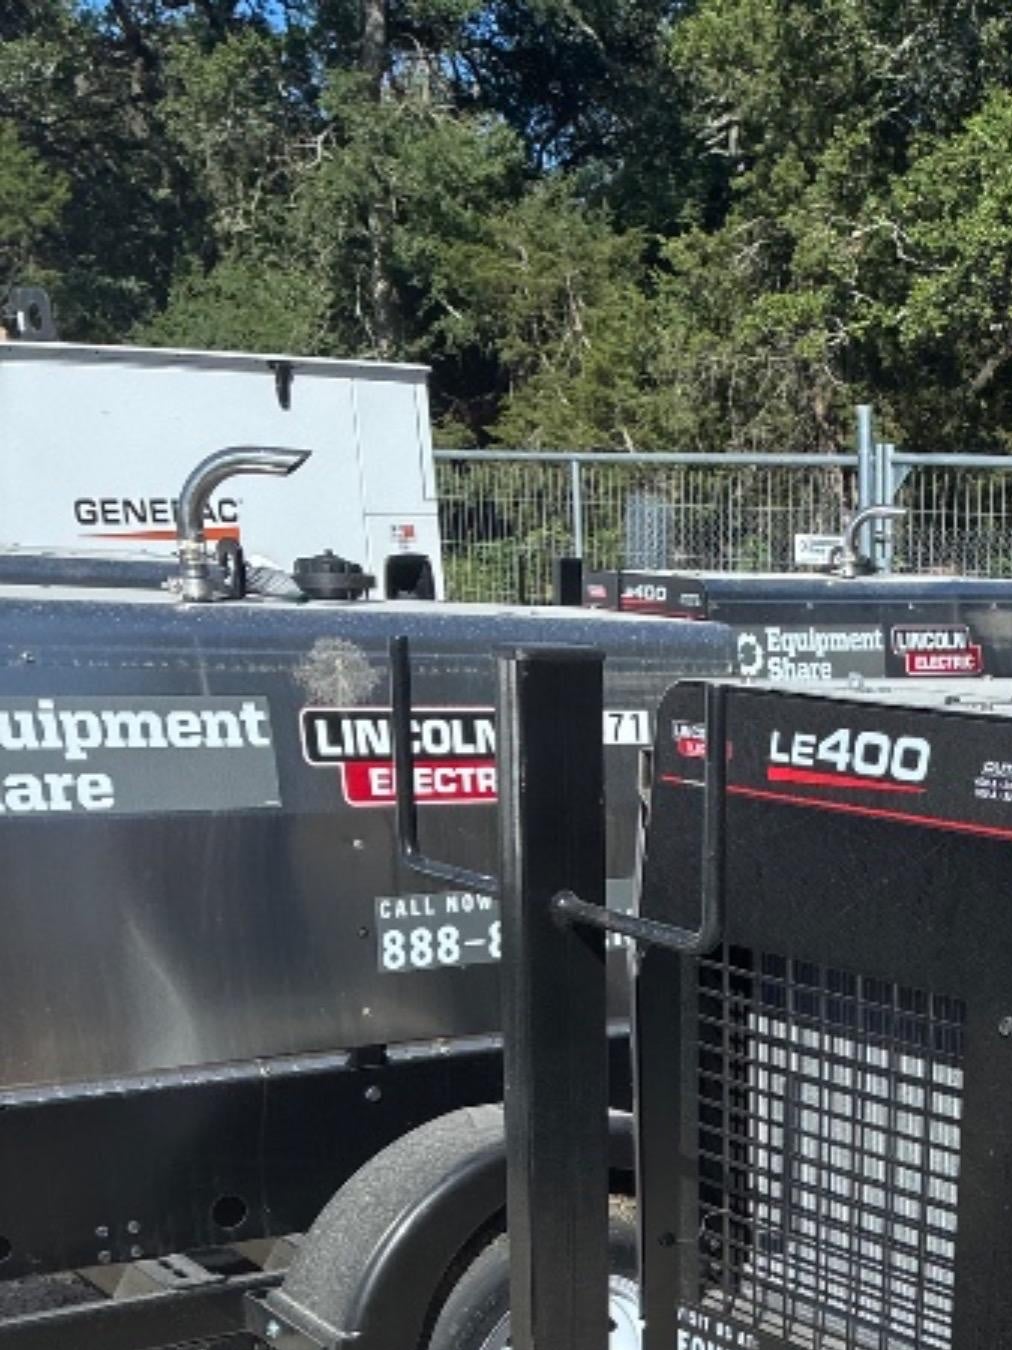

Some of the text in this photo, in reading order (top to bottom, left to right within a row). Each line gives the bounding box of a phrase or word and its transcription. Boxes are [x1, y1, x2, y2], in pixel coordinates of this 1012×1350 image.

[74, 498, 239, 525] GENEAC
[765, 627, 883, 659] Equipment
[897, 629, 967, 650] LINCOLN
[768, 660, 833, 681] Share
[607, 713, 641, 742] 71
[769, 727, 931, 782] LE400
[0, 773, 115, 812] are
[367, 766, 498, 797] EECTR
[380, 893, 493, 919] CALL NOW
